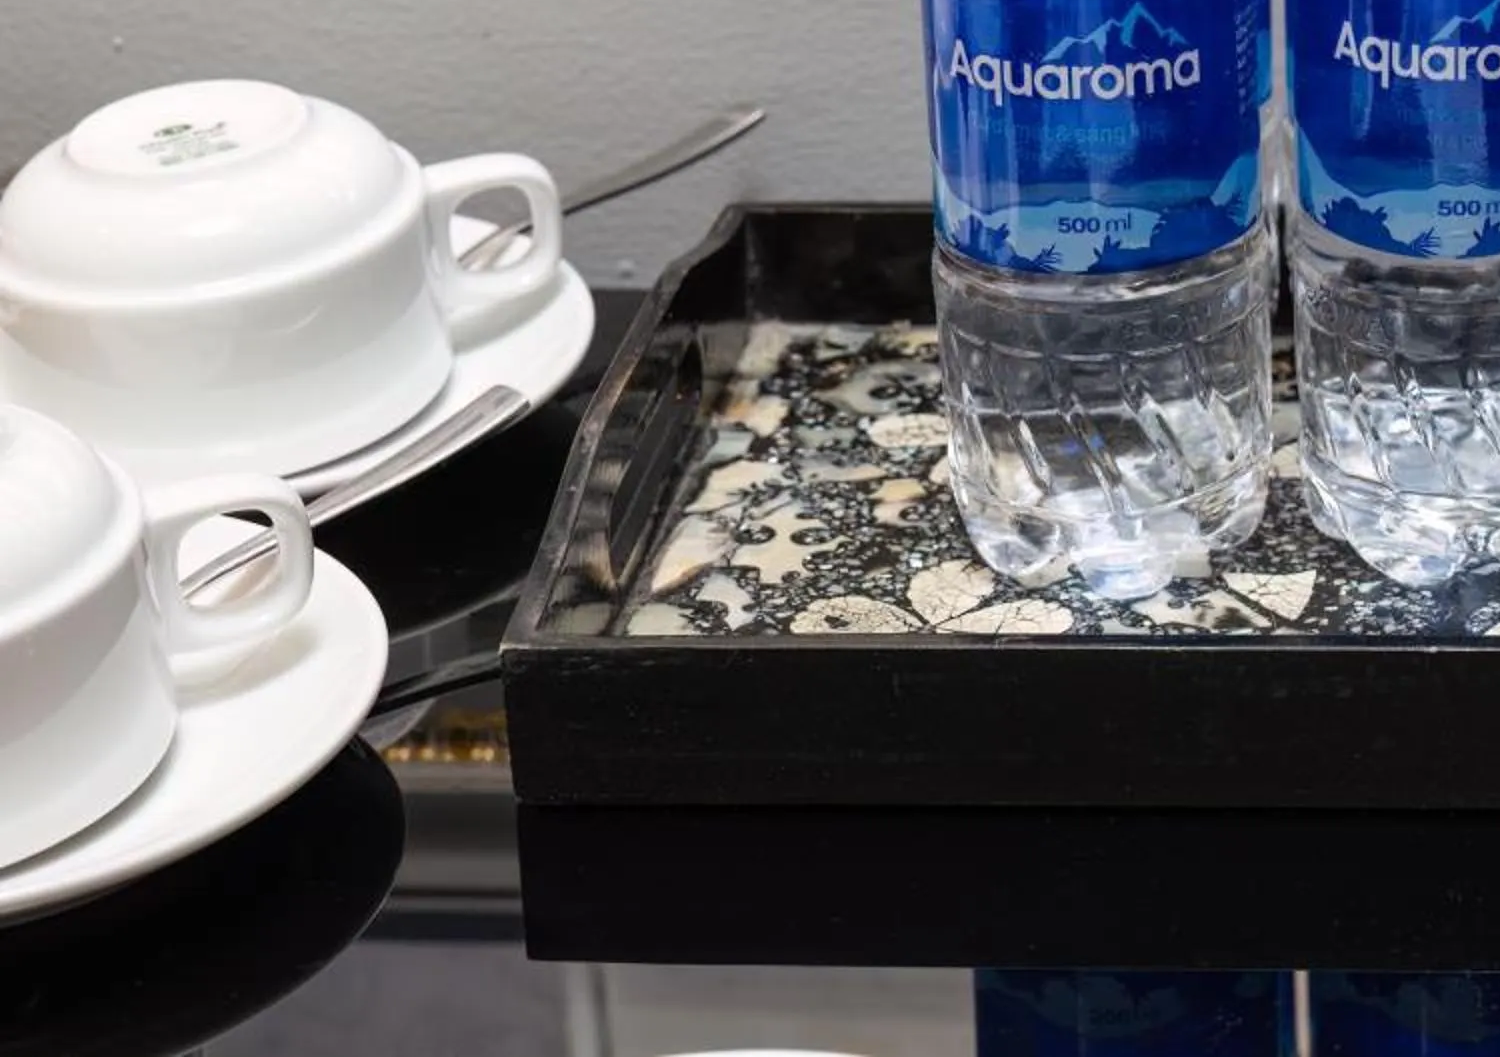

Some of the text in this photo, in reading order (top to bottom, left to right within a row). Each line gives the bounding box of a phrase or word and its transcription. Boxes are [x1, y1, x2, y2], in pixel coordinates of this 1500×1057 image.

[950, 38, 1201, 107] Aquaroma
[1438, 199, 1482, 217] 500
[1057, 213, 1132, 234] 500 ml
